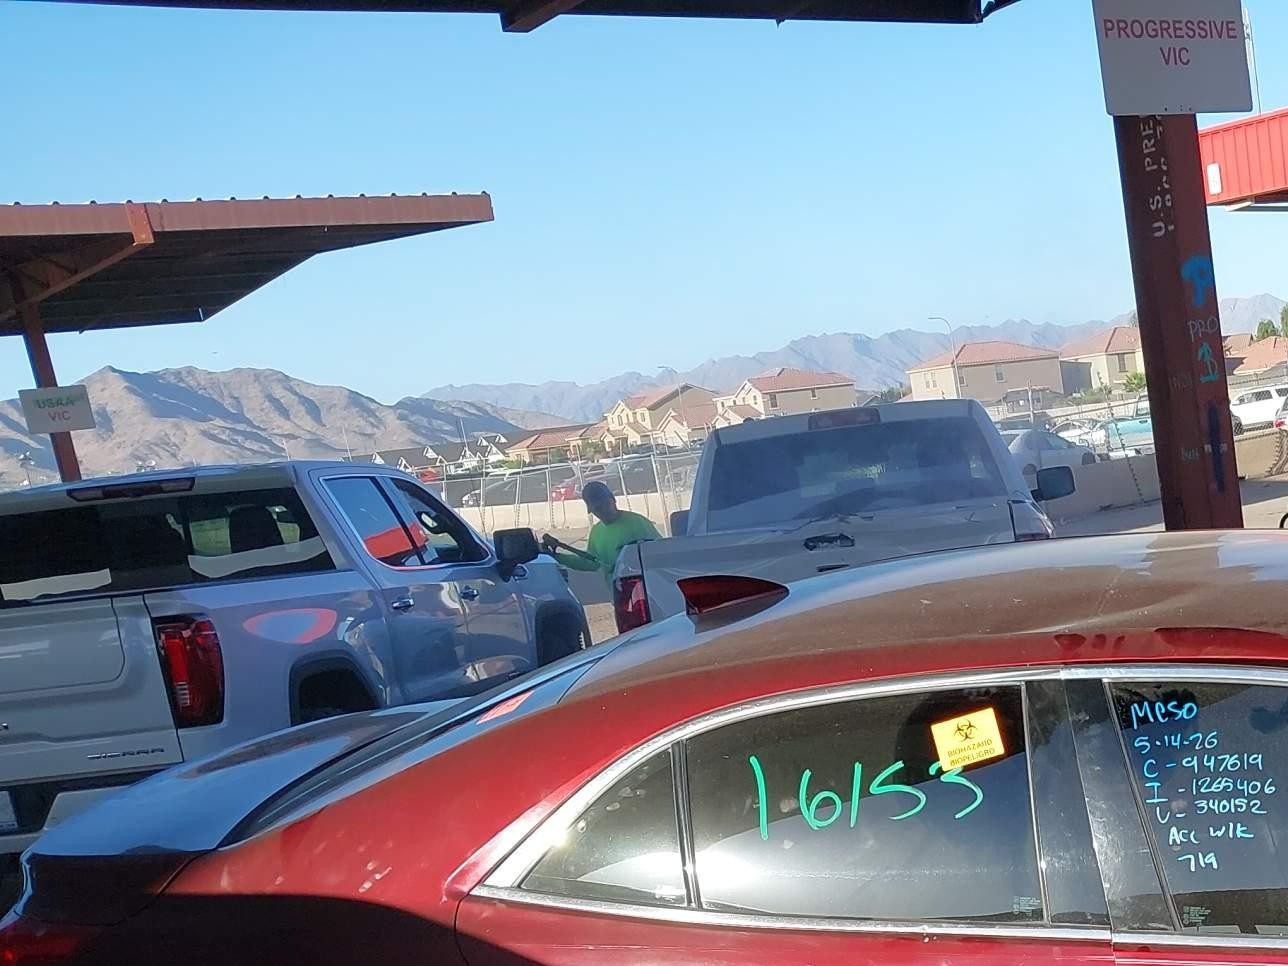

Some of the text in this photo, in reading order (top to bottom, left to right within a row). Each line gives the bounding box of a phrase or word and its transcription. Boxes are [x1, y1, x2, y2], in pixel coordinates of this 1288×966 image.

[1103, 19, 1238, 39] PROGRESSIVE
[1160, 47, 1190, 66] VIC
[1140, 113, 1158, 171] PRE
[47, 410, 71, 421] VIC
[950, 747, 996, 767] BIOPELIGRO
